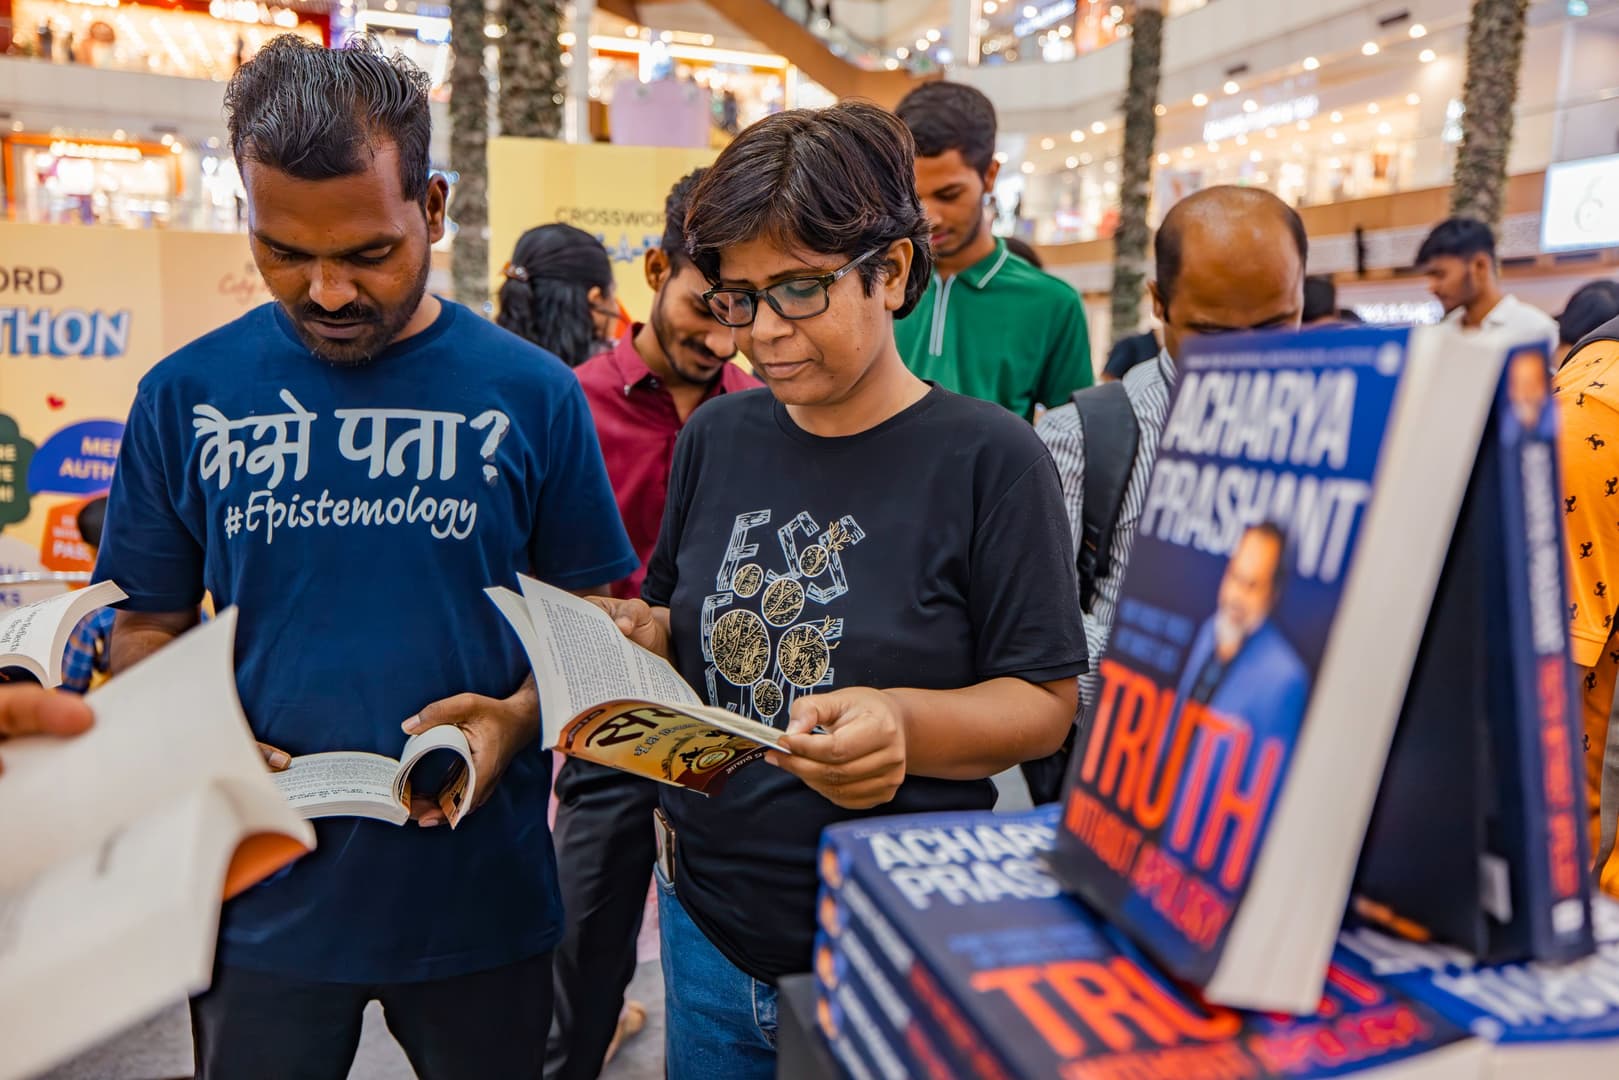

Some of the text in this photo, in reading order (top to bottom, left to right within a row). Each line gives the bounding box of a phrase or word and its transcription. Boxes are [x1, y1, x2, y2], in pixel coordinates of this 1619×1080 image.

[193, 388, 511, 491] कैसे पता?
[1160, 369, 1357, 470] ACHARYA
[224, 485, 477, 545] #Epistemology
[1081, 658, 1284, 890] TRUTH
